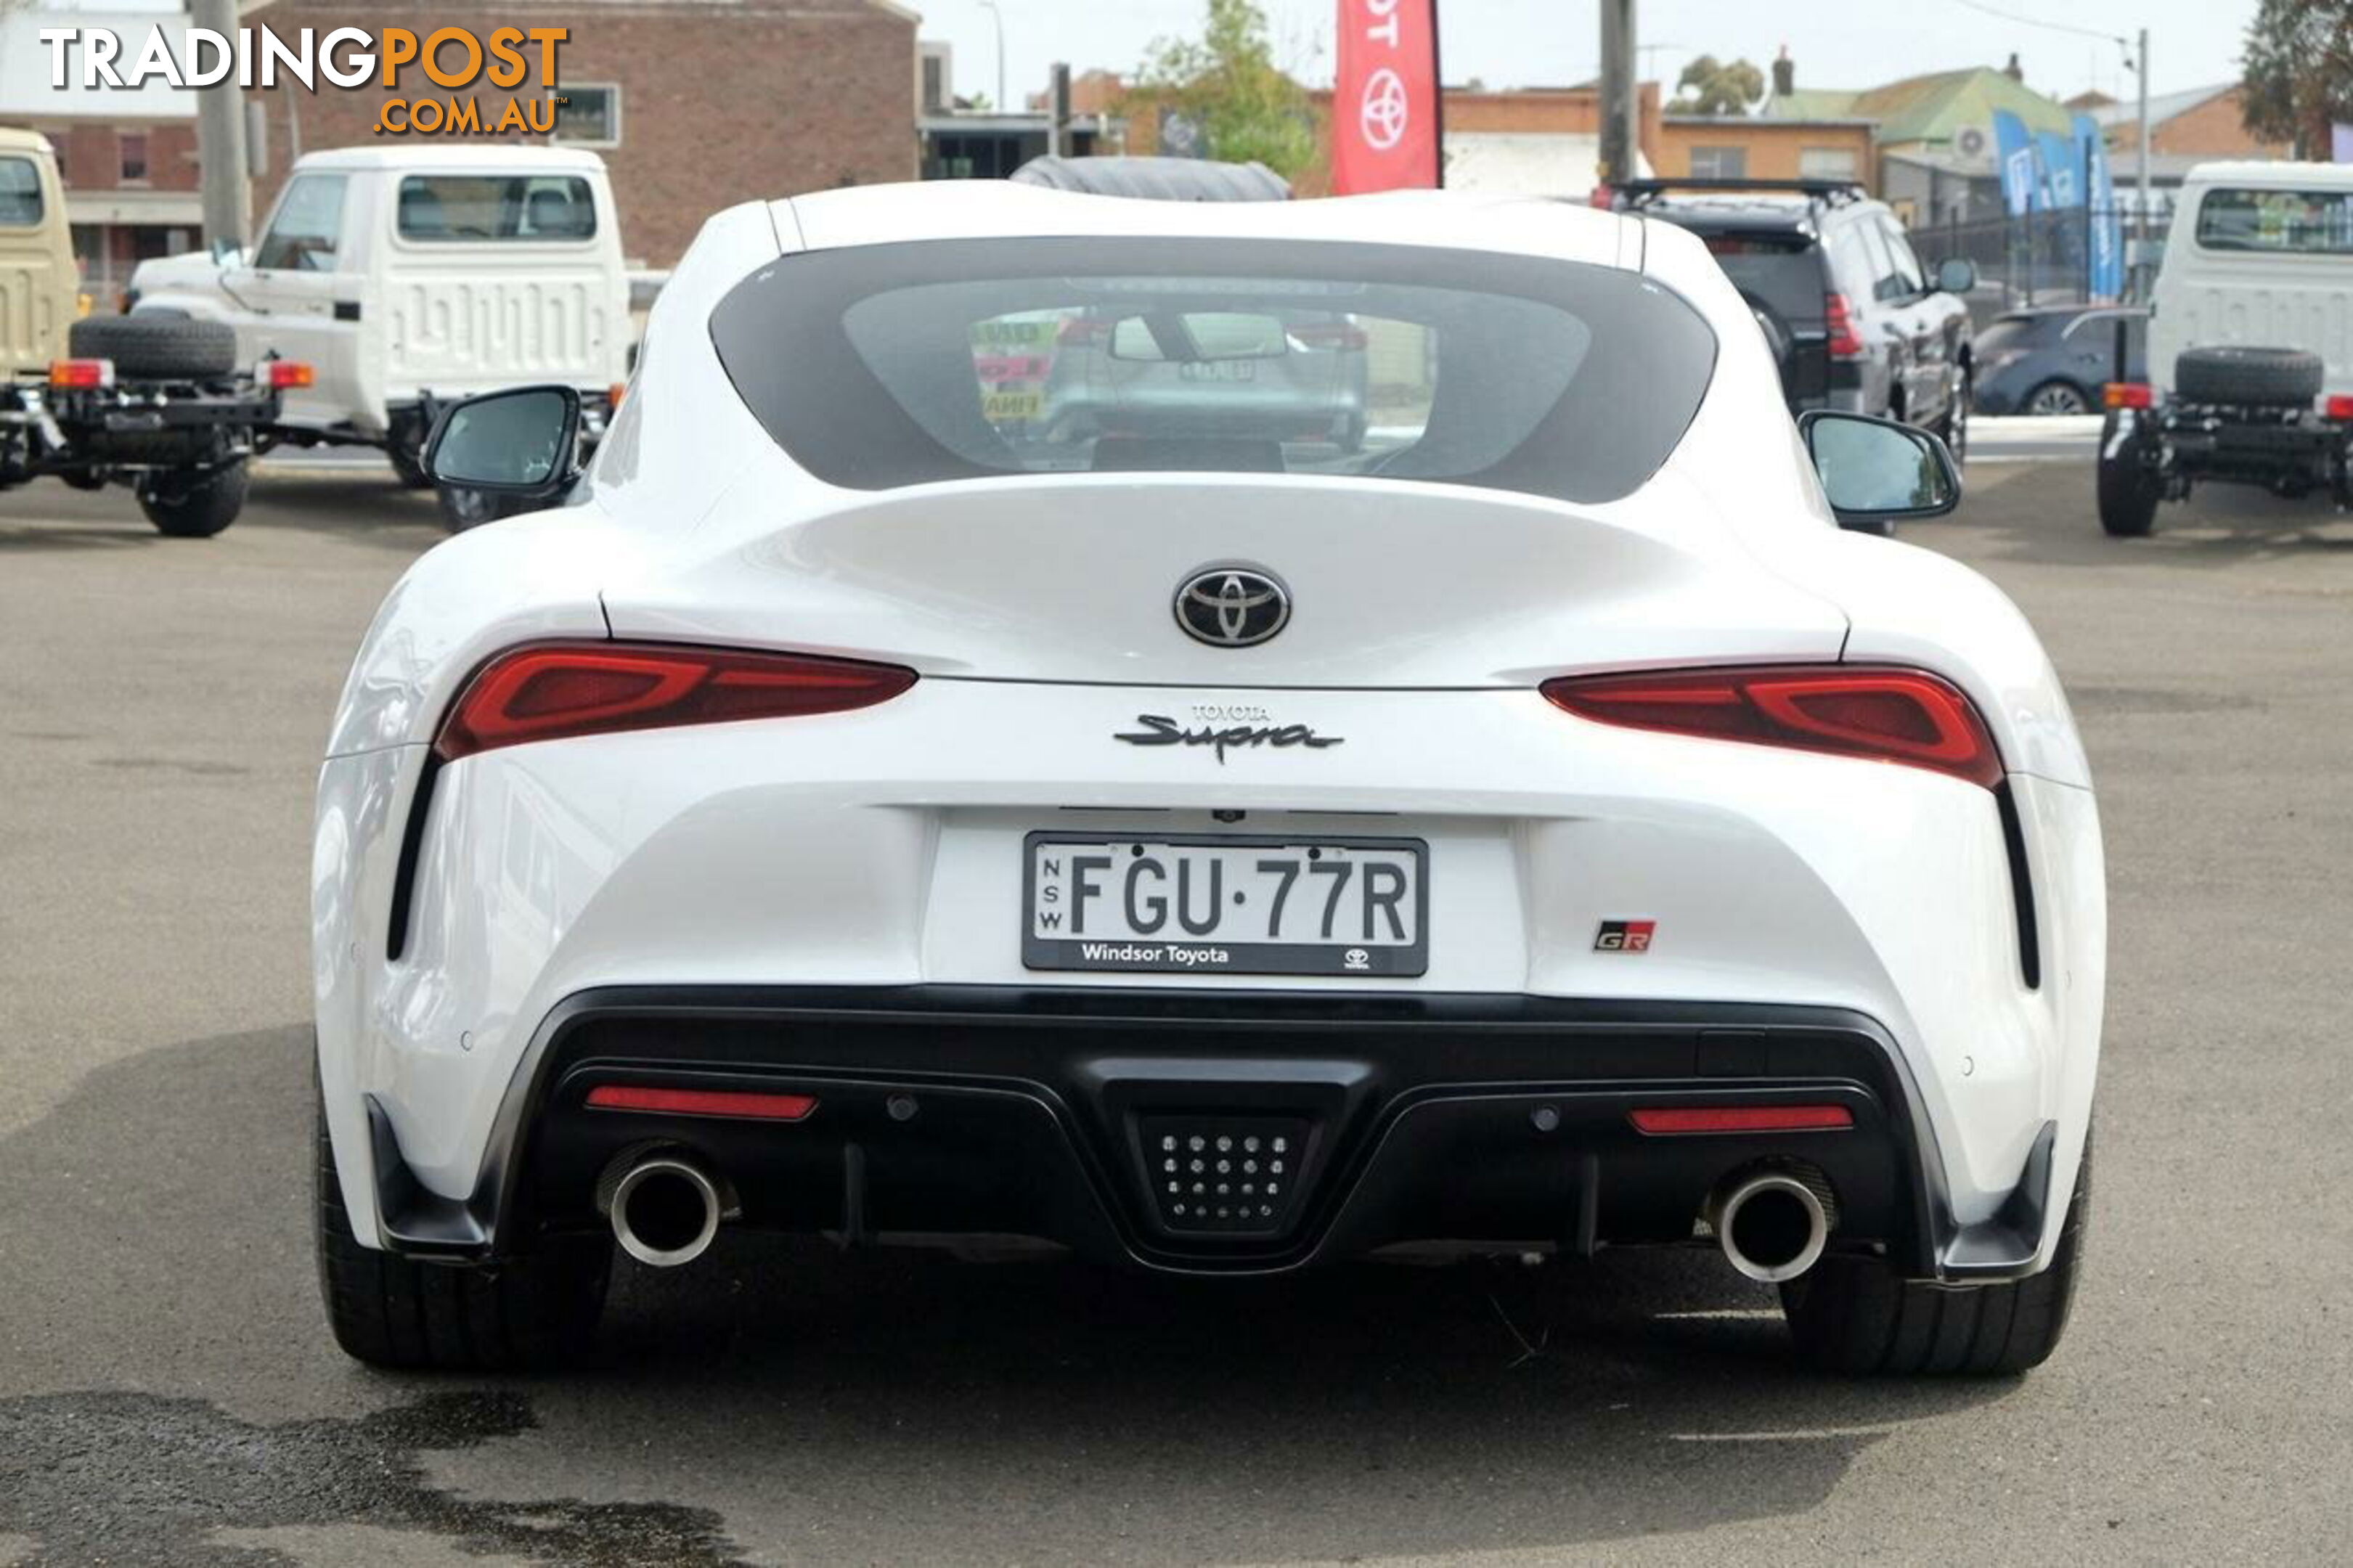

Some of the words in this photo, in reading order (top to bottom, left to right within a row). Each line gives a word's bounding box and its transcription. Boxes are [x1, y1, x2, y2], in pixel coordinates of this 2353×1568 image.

[1191, 706, 1271, 722] TOYOTA
[1113, 714, 1345, 765] Supra
[1597, 932, 1649, 950] GR
[1082, 944, 1162, 963] Windsor
[1165, 945, 1229, 965] Toyota
